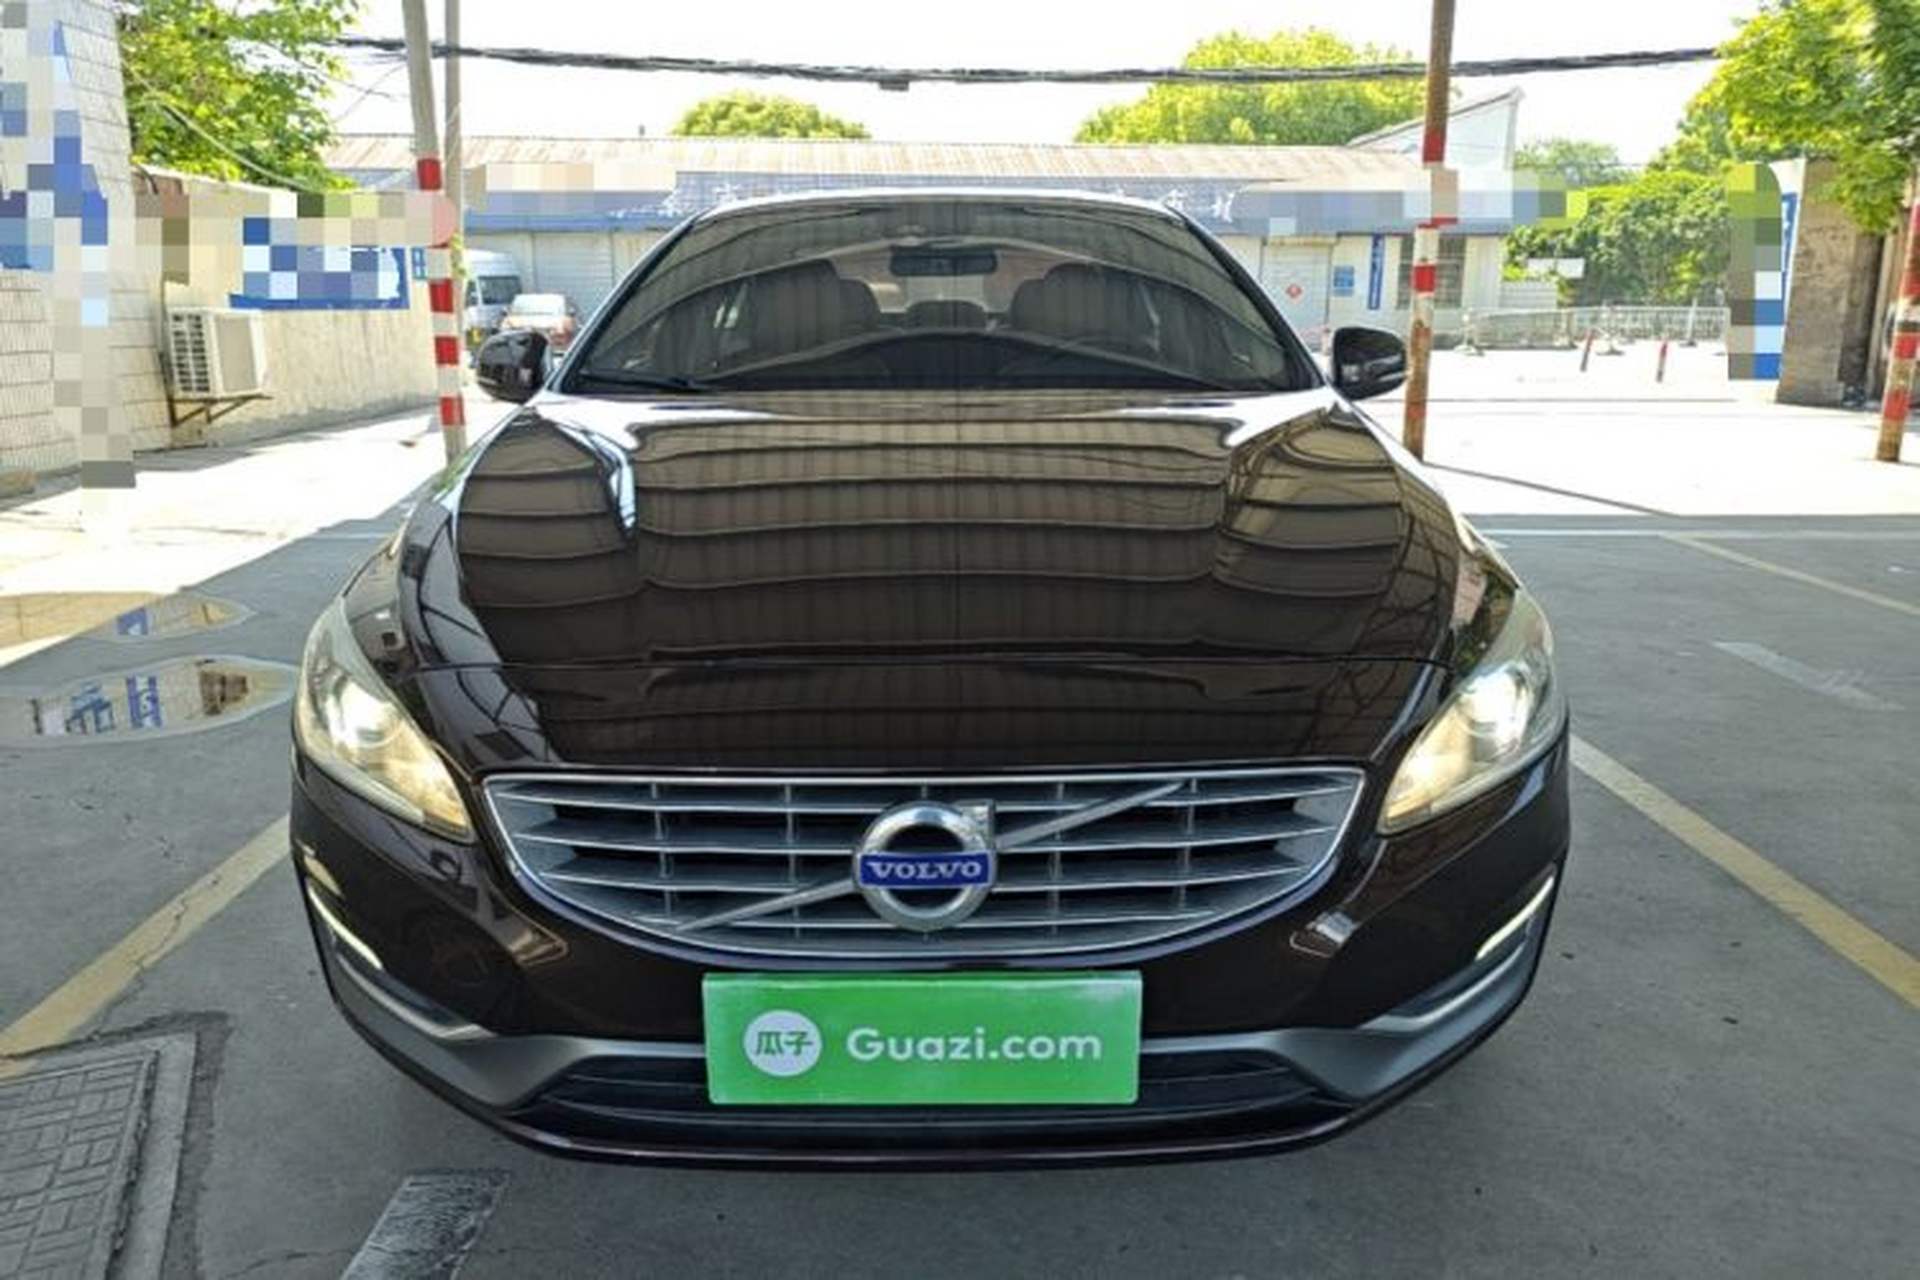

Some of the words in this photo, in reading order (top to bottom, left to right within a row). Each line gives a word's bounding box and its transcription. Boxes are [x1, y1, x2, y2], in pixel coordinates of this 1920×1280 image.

[866, 860, 983, 880] VOLVO
[755, 1030, 814, 1057] 瓜子
[846, 1026, 1103, 1062] Guazi.com
